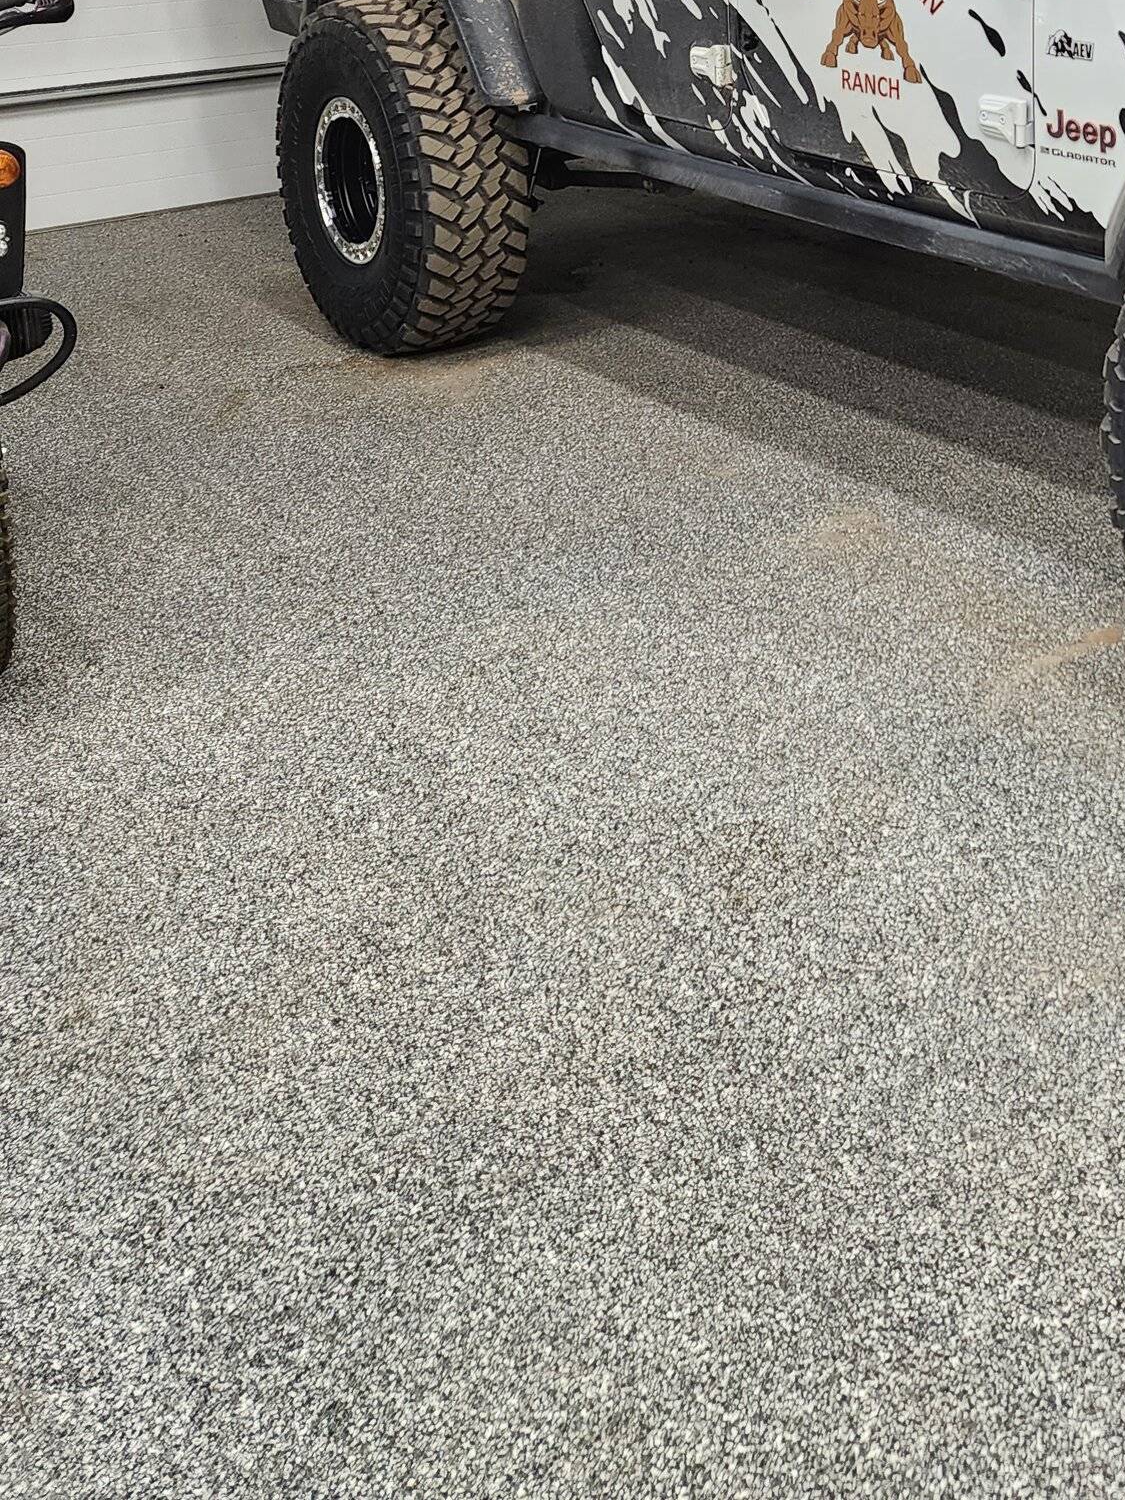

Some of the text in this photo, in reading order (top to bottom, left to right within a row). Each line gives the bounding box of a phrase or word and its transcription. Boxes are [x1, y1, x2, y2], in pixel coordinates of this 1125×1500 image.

[1073, 42, 1092, 59] AEV
[841, 68, 900, 100] RANCH
[1046, 108, 1117, 153] Jeep
[1051, 147, 1117, 167] GLADIATOR
